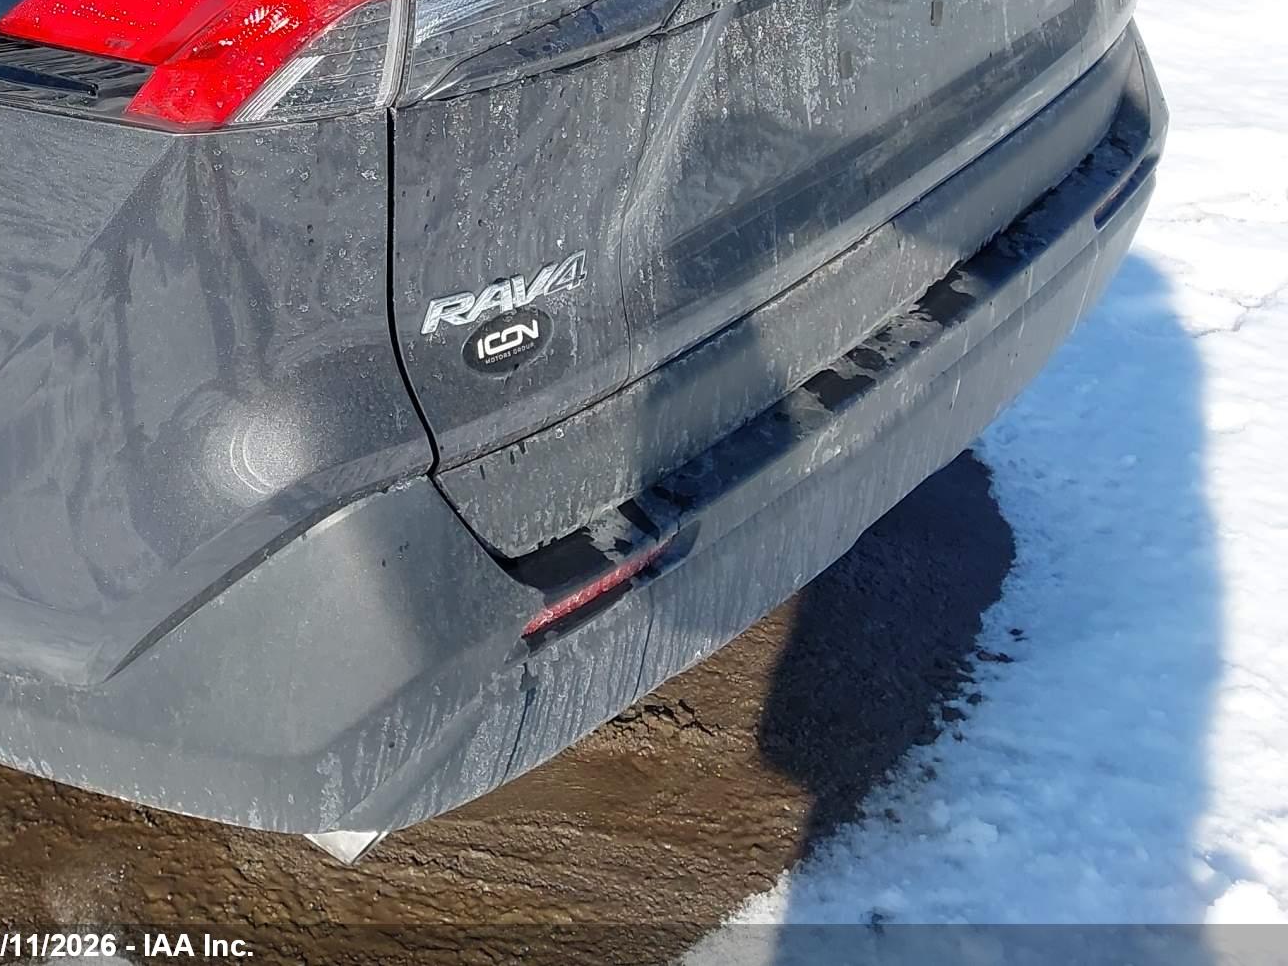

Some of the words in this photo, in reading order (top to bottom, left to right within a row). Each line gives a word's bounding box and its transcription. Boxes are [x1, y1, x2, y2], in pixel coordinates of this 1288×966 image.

[420, 248, 588, 334] RAV4
[476, 319, 540, 360] ICON
[484, 350, 512, 365] MOTORS
[512, 341, 535, 356] GROUP
